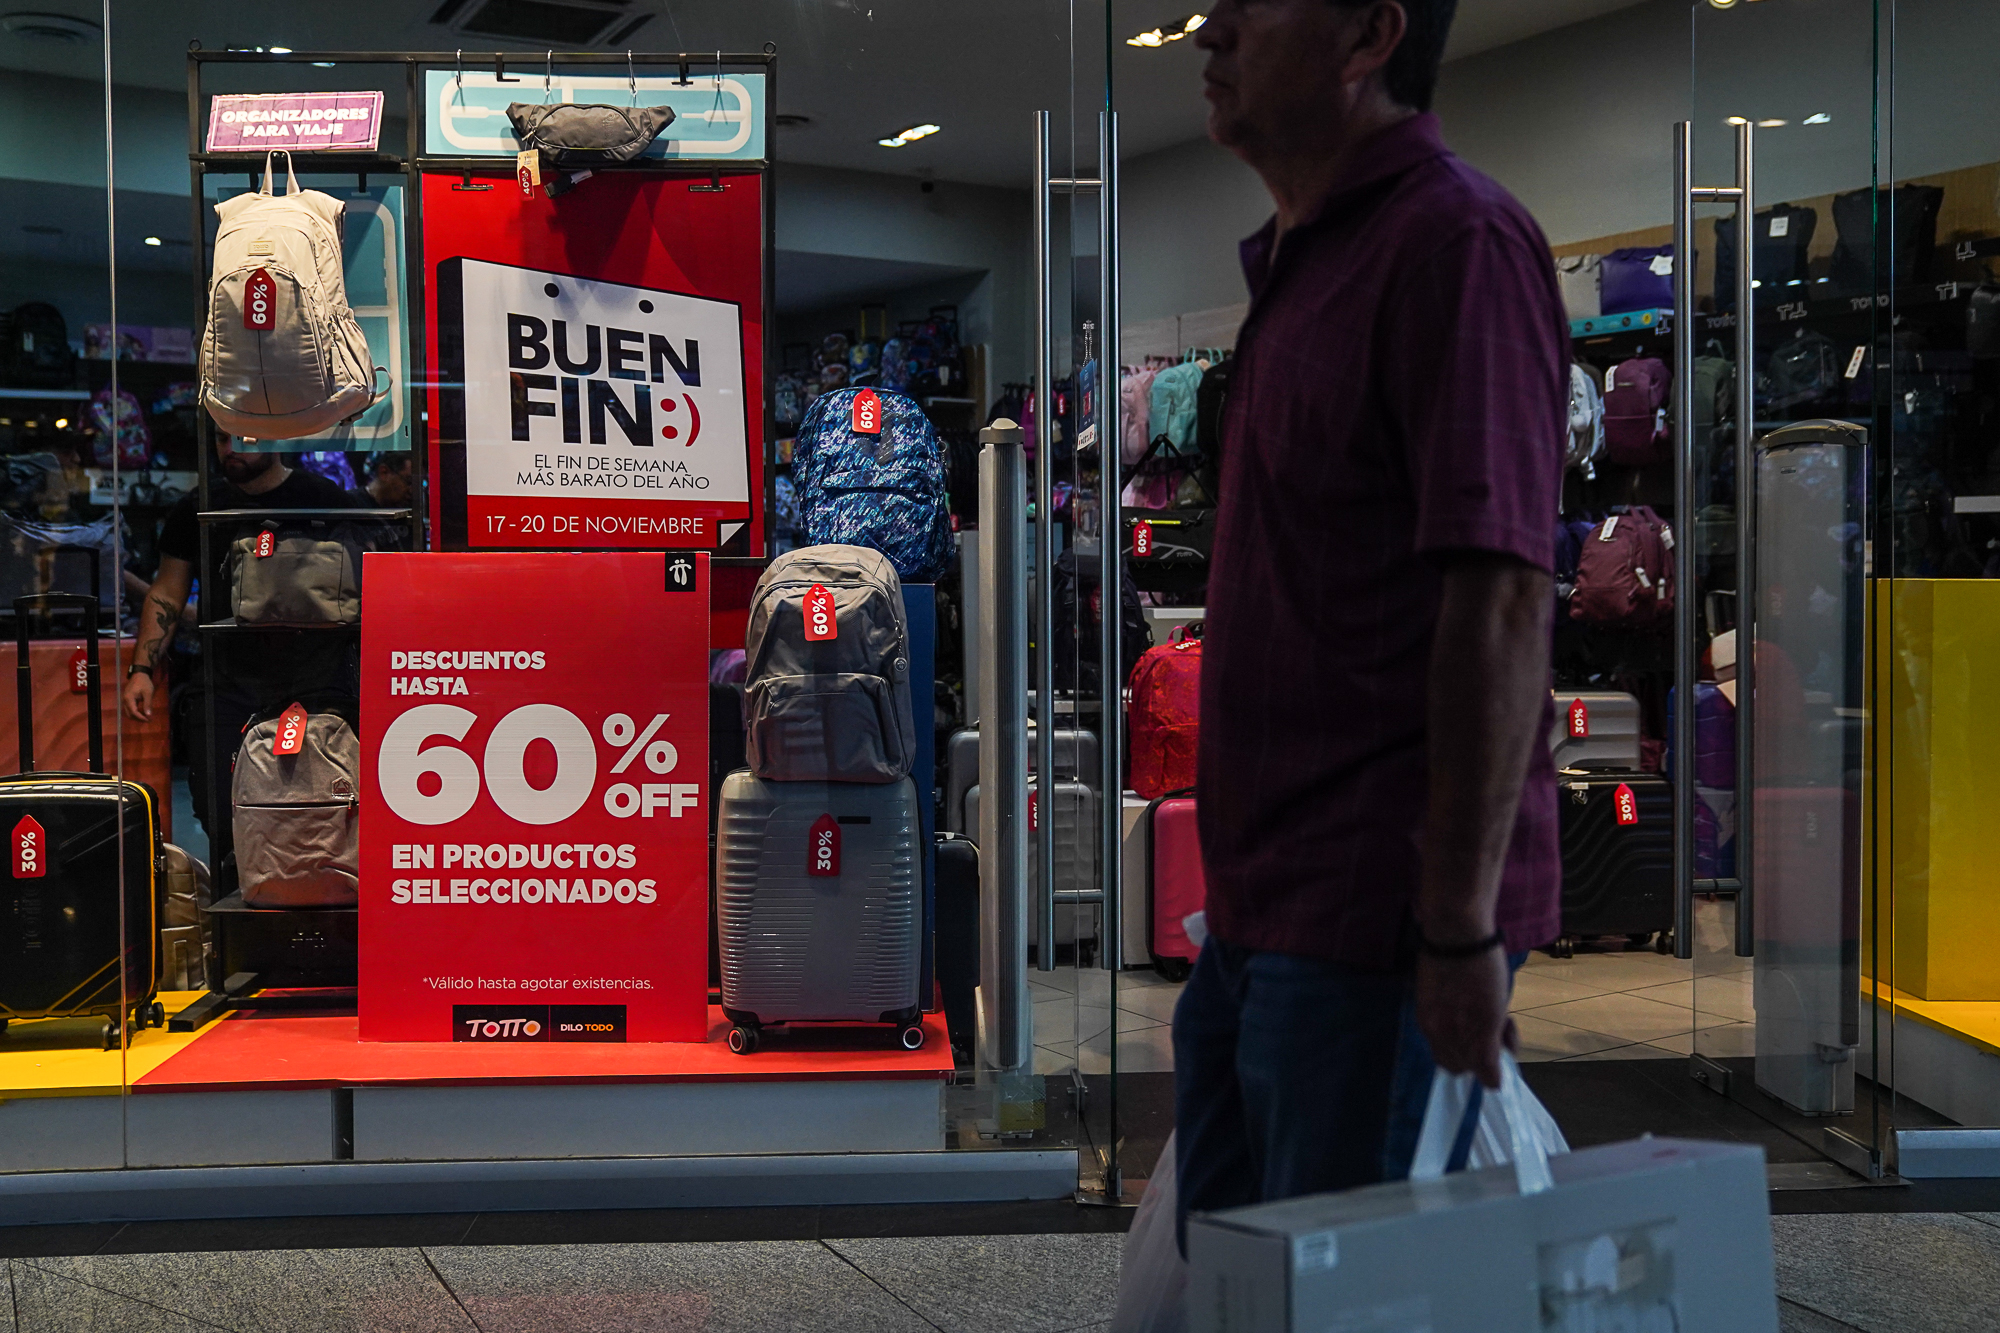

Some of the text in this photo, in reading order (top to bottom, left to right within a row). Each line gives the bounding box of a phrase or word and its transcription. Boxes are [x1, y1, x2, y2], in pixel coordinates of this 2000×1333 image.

[221, 108, 369, 123] ORGANIZADORES
[242, 123, 344, 137] PARA VIAJE
[252, 284, 268, 324] 60%
[507, 313, 701, 387] BUEN
[860, 399, 874, 429] 60%
[535, 454, 688, 473] EL FIN DE SEMANA
[517, 469, 710, 490] MÁS BARATO DEL AÑO
[553, 516, 579, 533] DE
[586, 517, 703, 534] NOVIEMBRE
[260, 534, 270, 556] 60%
[1138, 529, 1147, 554] 60%
[812, 596, 829, 636] 60%
[76, 659, 87, 687] 30%
[391, 651, 546, 670] DESCUENTOS
[391, 677, 470, 695] HASTA
[281, 715, 300, 750] 60%
[1575, 708, 1585, 733] 30%
[603, 783, 699, 818] OFF
[1620, 793, 1633, 821] 30%
[21, 832, 36, 872] 30%
[392, 844, 637, 869] EN PRODUCTOS
[817, 830, 833, 871] 30%
[391, 878, 657, 904] SELECCIONADOS
[478, 977, 517, 990] hasta
[520, 979, 569, 992] agotar
[572, 977, 654, 990] existencias.
[466, 1018, 541, 1037] TOTTO
[560, 1023, 614, 1032] DILO TODO
